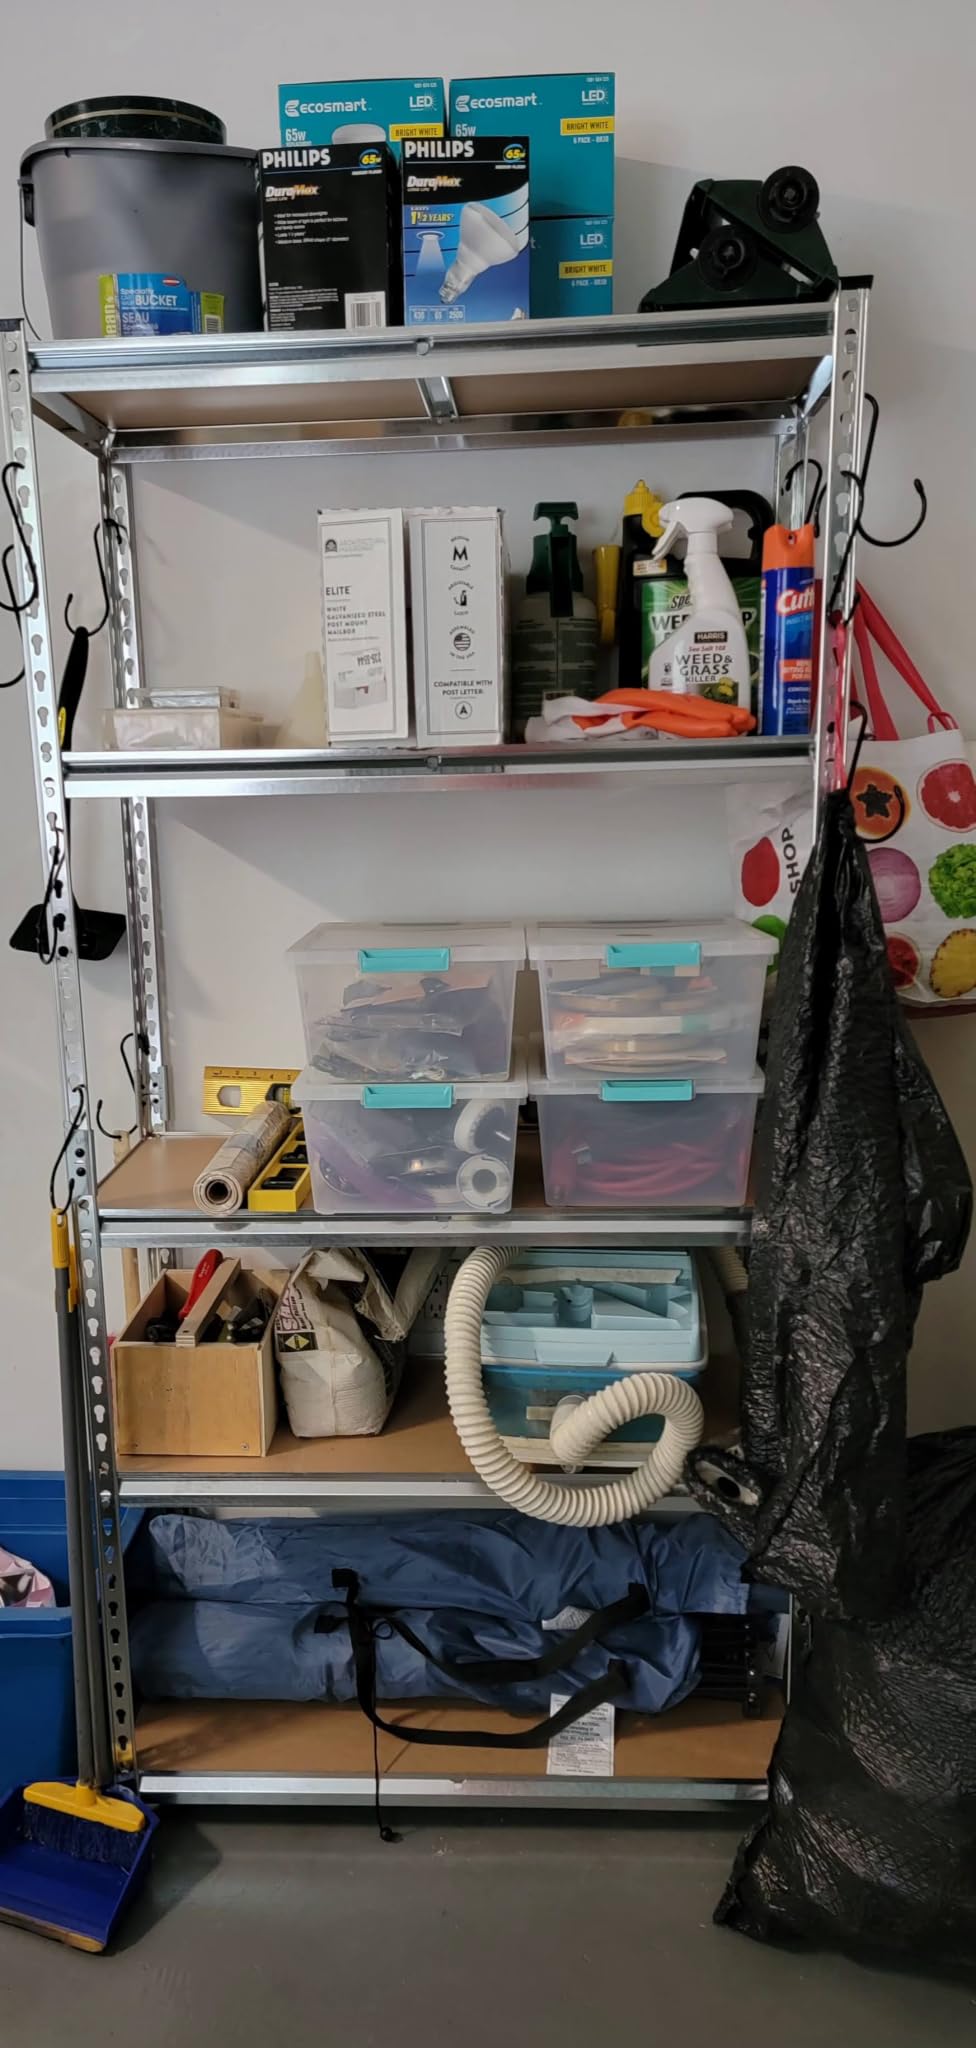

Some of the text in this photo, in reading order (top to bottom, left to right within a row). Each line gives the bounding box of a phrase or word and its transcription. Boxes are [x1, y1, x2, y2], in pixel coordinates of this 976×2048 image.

[409, 95, 433, 108] LED
[470, 92, 538, 109] ecosmart
[582, 89, 605, 102] LED
[300, 98, 367, 114] ecosmart
[567, 120, 609, 131] BRIGHT WHITE
[395, 127, 439, 138] BRIGHT WHITE
[404, 140, 474, 158] PHILIPS
[262, 148, 331, 169] PHILIPS
[406, 175, 462, 191] DuraMax
[265, 184, 319, 200] DuraMax
[580, 233, 604, 246] LED
[564, 264, 607, 274] BRIGHT WHITE
[135, 294, 178, 307] BUCKET
[122, 311, 150, 323] SEAU
[453, 545, 468, 561] M
[325, 585, 351, 596] ELITE
[777, 586, 814, 613] Cutt
[345, 619, 368, 627] MOUNT
[697, 632, 725, 640] HARRIS
[680, 664, 729, 676] GRASS
[433, 679, 493, 688] COMPATIBLE WITH
[685, 675, 717, 683] KILLER
[781, 827, 801, 894] SHOP
